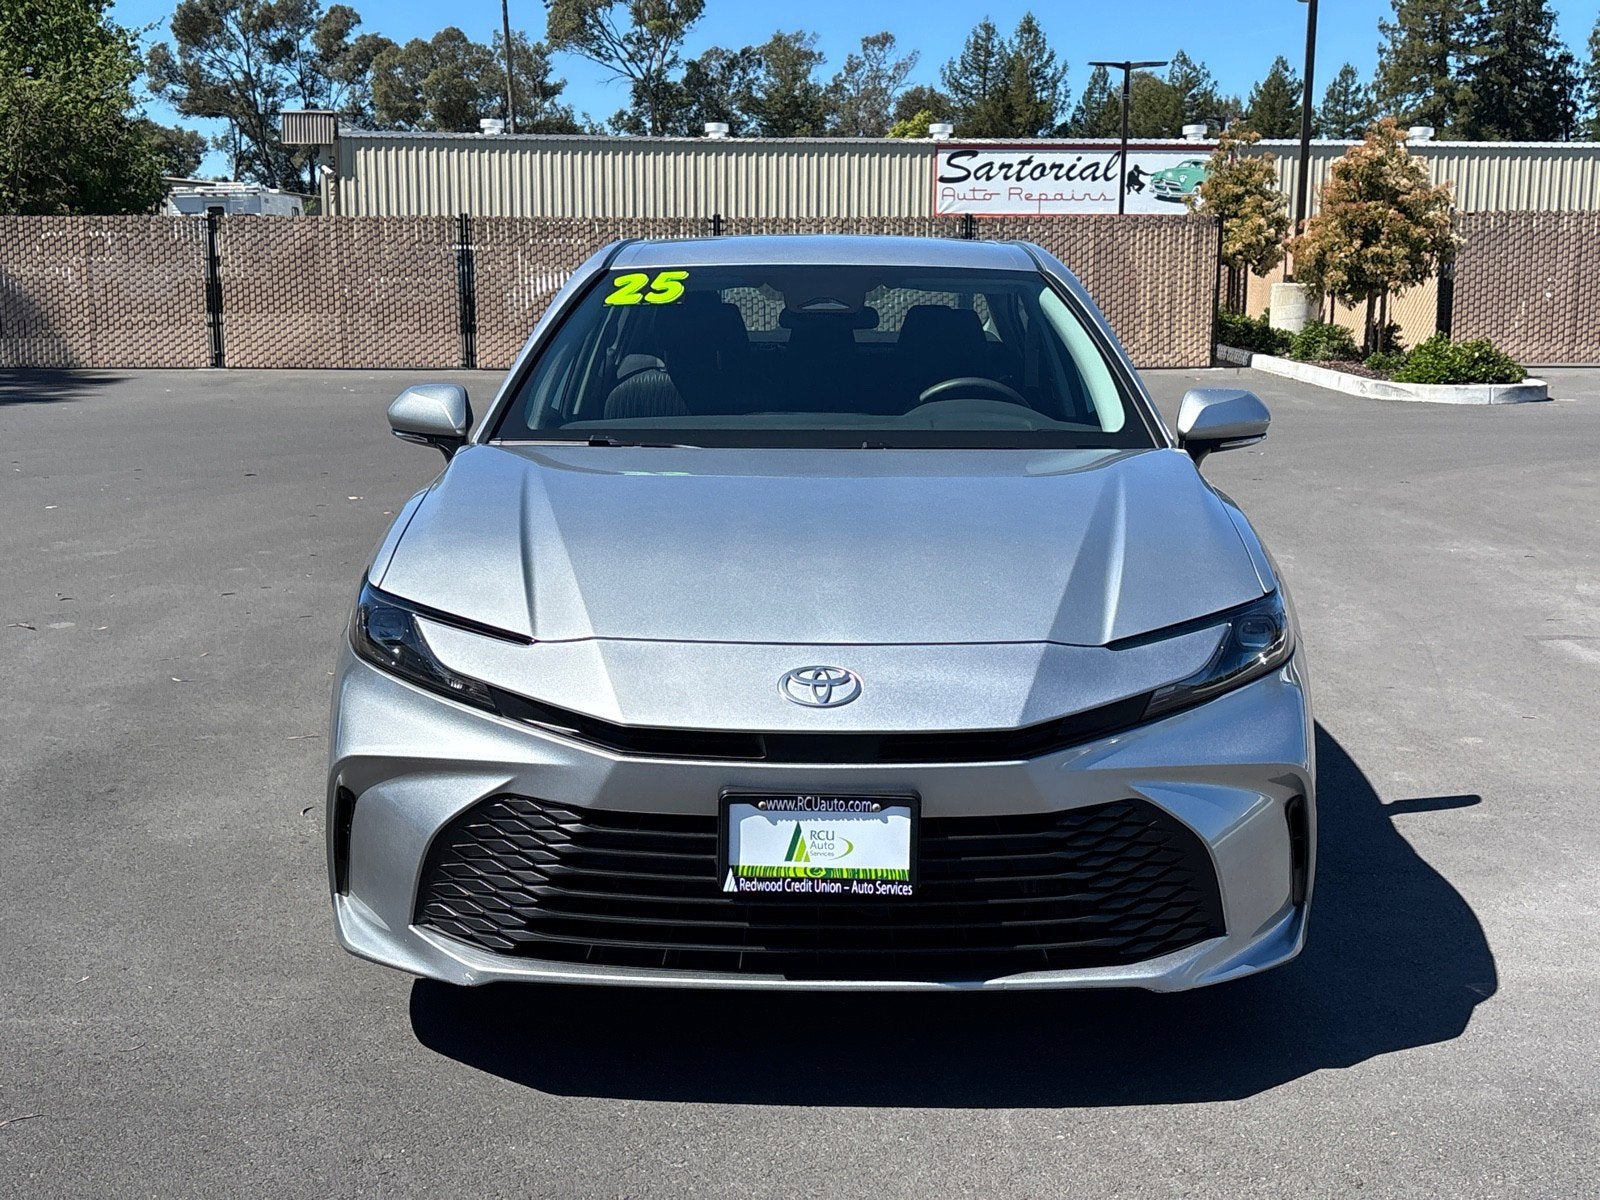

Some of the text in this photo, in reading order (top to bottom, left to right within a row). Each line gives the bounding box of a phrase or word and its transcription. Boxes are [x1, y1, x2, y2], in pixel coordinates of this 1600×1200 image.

[938, 150, 1121, 183] Sartorial
[942, 187, 1116, 213] Auto Repairs
[604, 271, 690, 306] 25
[766, 796, 872, 812] www.RCUauto.com
[810, 830, 835, 841] RCU
[810, 840, 835, 850] Auto
[740, 878, 782, 892] Redwood
[784, 878, 813, 893] Credit
[814, 879, 842, 893] Union
[851, 880, 874, 894] Auto
[875, 881, 913, 896] Services
